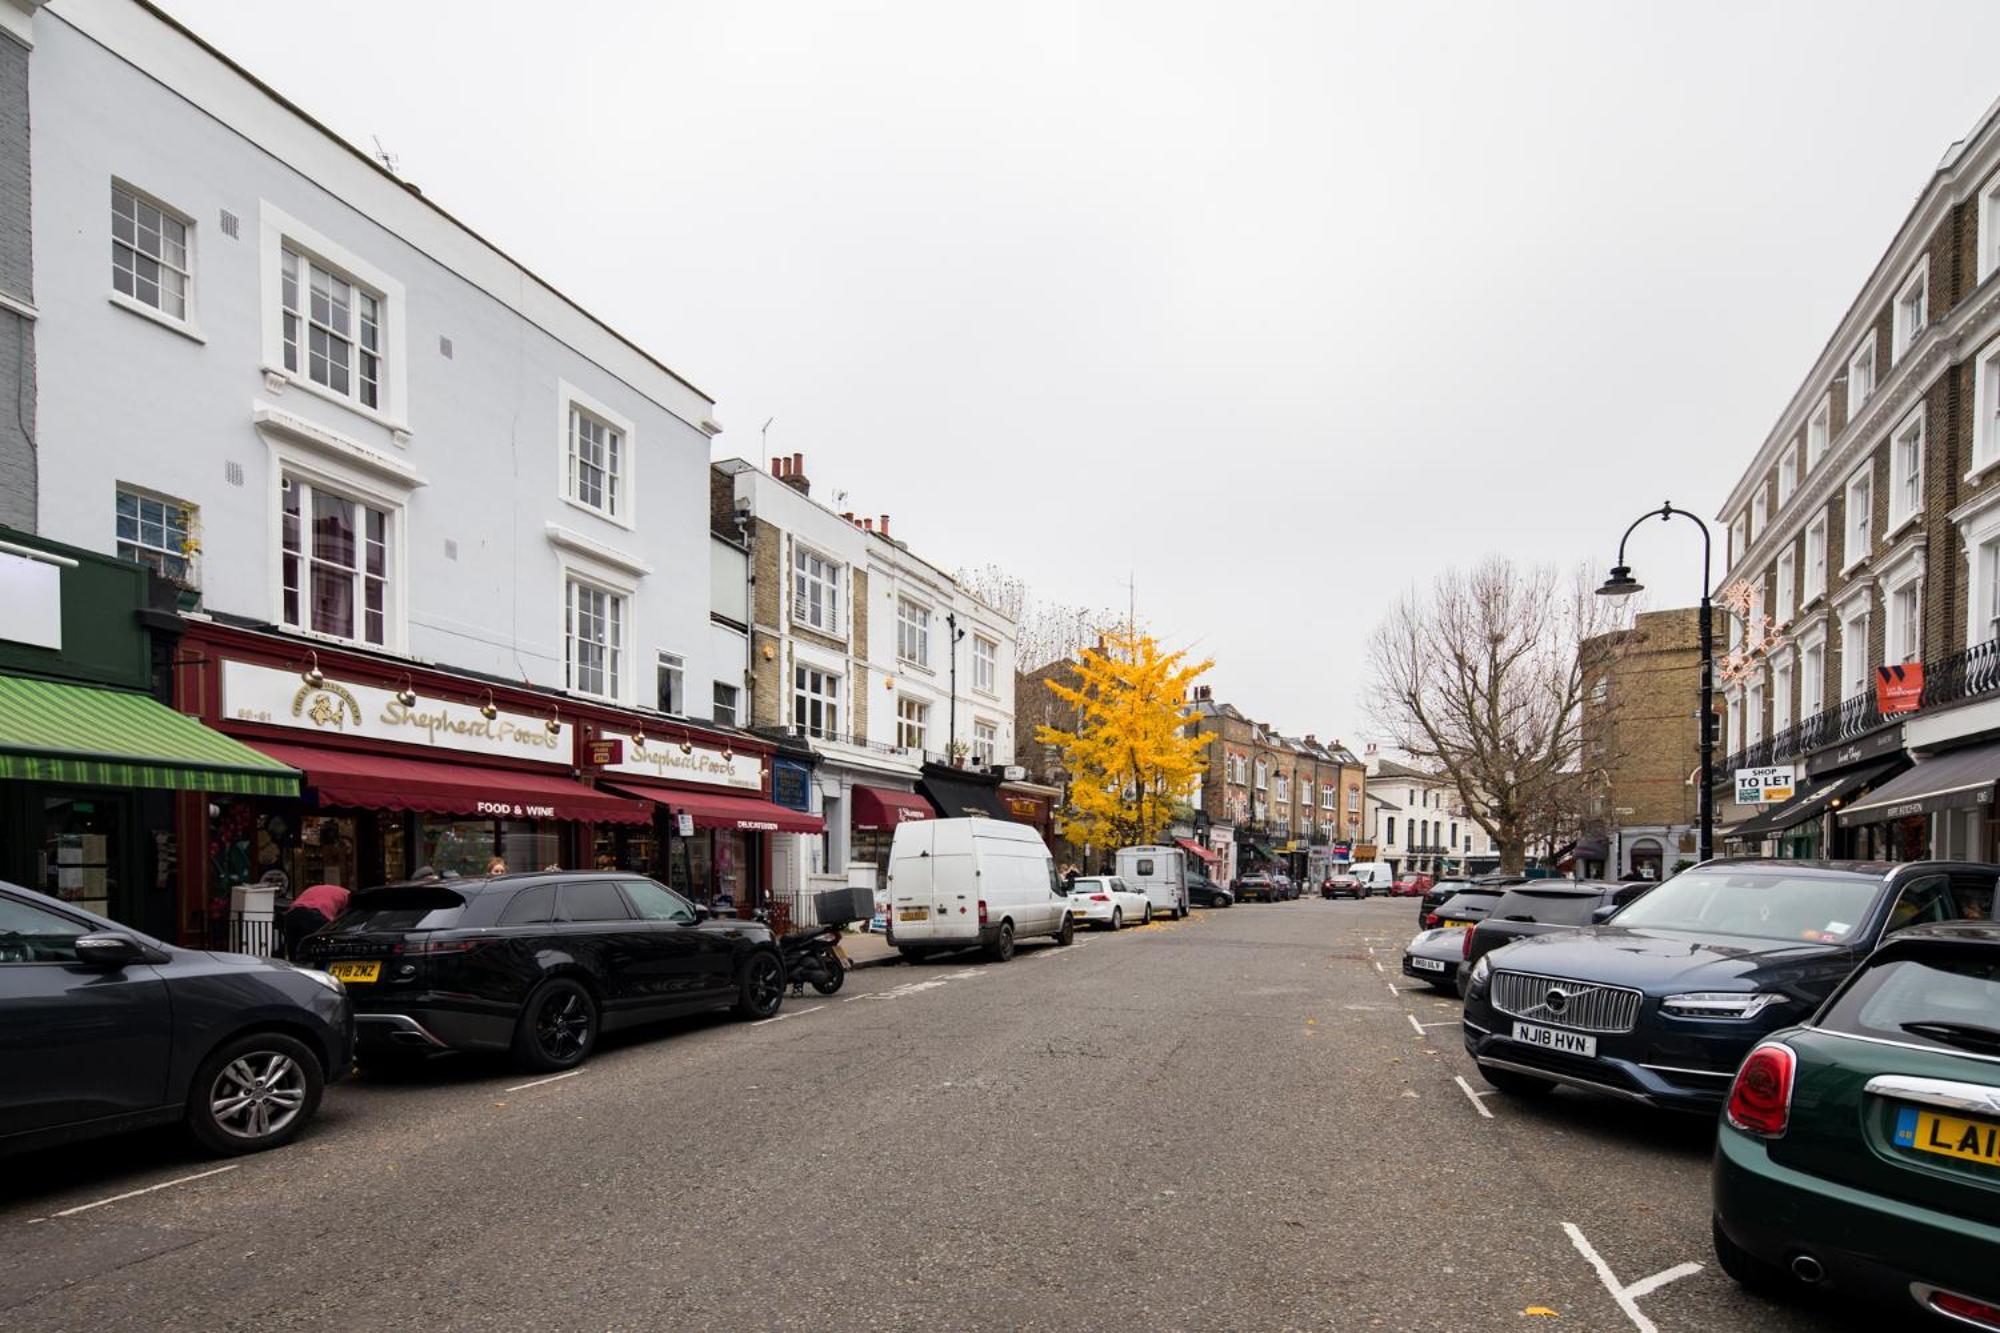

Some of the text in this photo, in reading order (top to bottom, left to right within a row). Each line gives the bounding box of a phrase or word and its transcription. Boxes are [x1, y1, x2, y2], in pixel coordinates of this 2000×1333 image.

[380, 701, 495, 744] Shepherd
[498, 719, 558, 750] Foods
[630, 746, 700, 775] Shepherd
[700, 754, 736, 777] Foods
[1752, 769, 1777, 777] SHOP
[1739, 775, 1791, 788] TO LET
[477, 801, 554, 817] FOOD & WINE
[1519, 1025, 1587, 1052] NJ18 HVN
[1930, 1118, 2000, 1159] LA1
